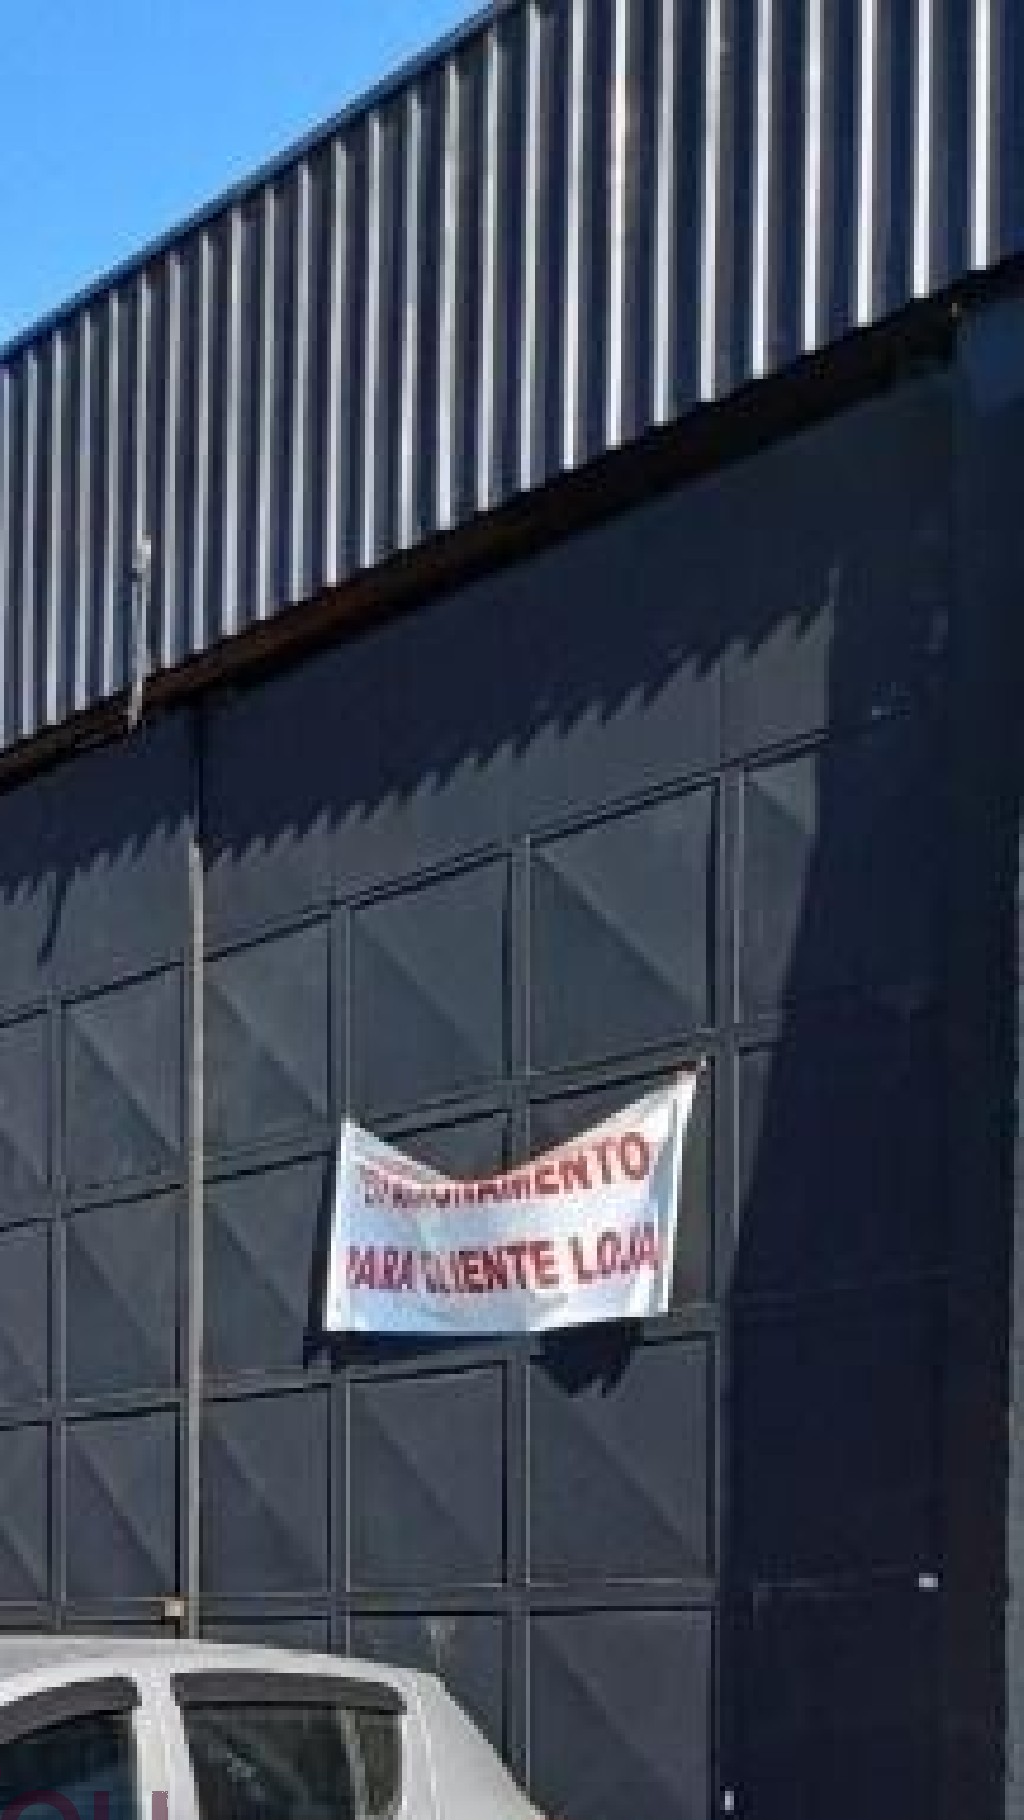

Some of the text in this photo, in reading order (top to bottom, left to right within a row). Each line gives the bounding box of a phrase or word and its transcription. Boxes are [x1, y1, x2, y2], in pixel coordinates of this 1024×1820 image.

[357, 1132, 652, 1210] ONAMENTO
[347, 1222, 659, 1294] PARA CLIENTE LOJA
